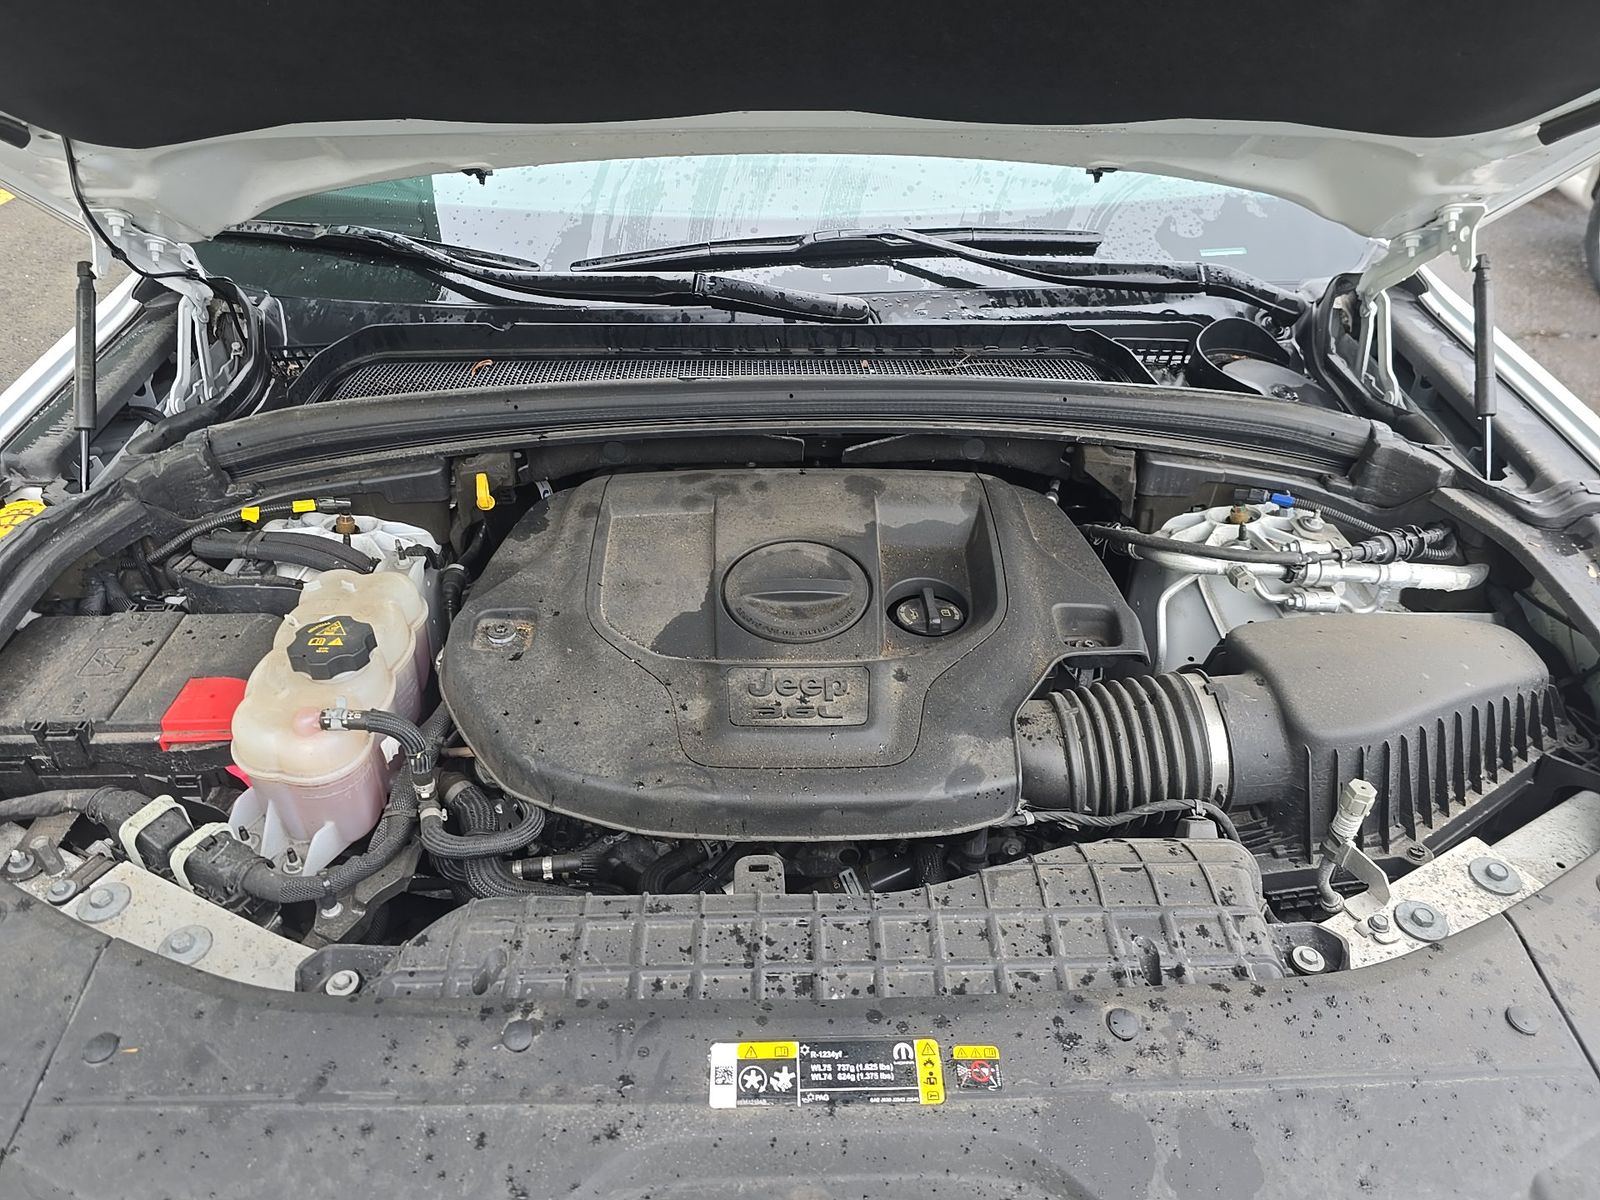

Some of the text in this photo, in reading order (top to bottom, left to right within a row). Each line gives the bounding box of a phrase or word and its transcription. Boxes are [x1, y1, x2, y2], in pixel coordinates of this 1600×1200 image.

[748, 669, 849, 702] Jeep
[751, 705, 844, 720] 3.6L
[810, 1050, 843, 1060] R-1234yf
[810, 1064, 832, 1072] WL75
[837, 1063, 855, 1073] 737g
[879, 1062, 894, 1072] lbs)
[810, 1072, 895, 1082] WL74 624g (1.375 lbs)
[815, 1094, 830, 1102] PAG
